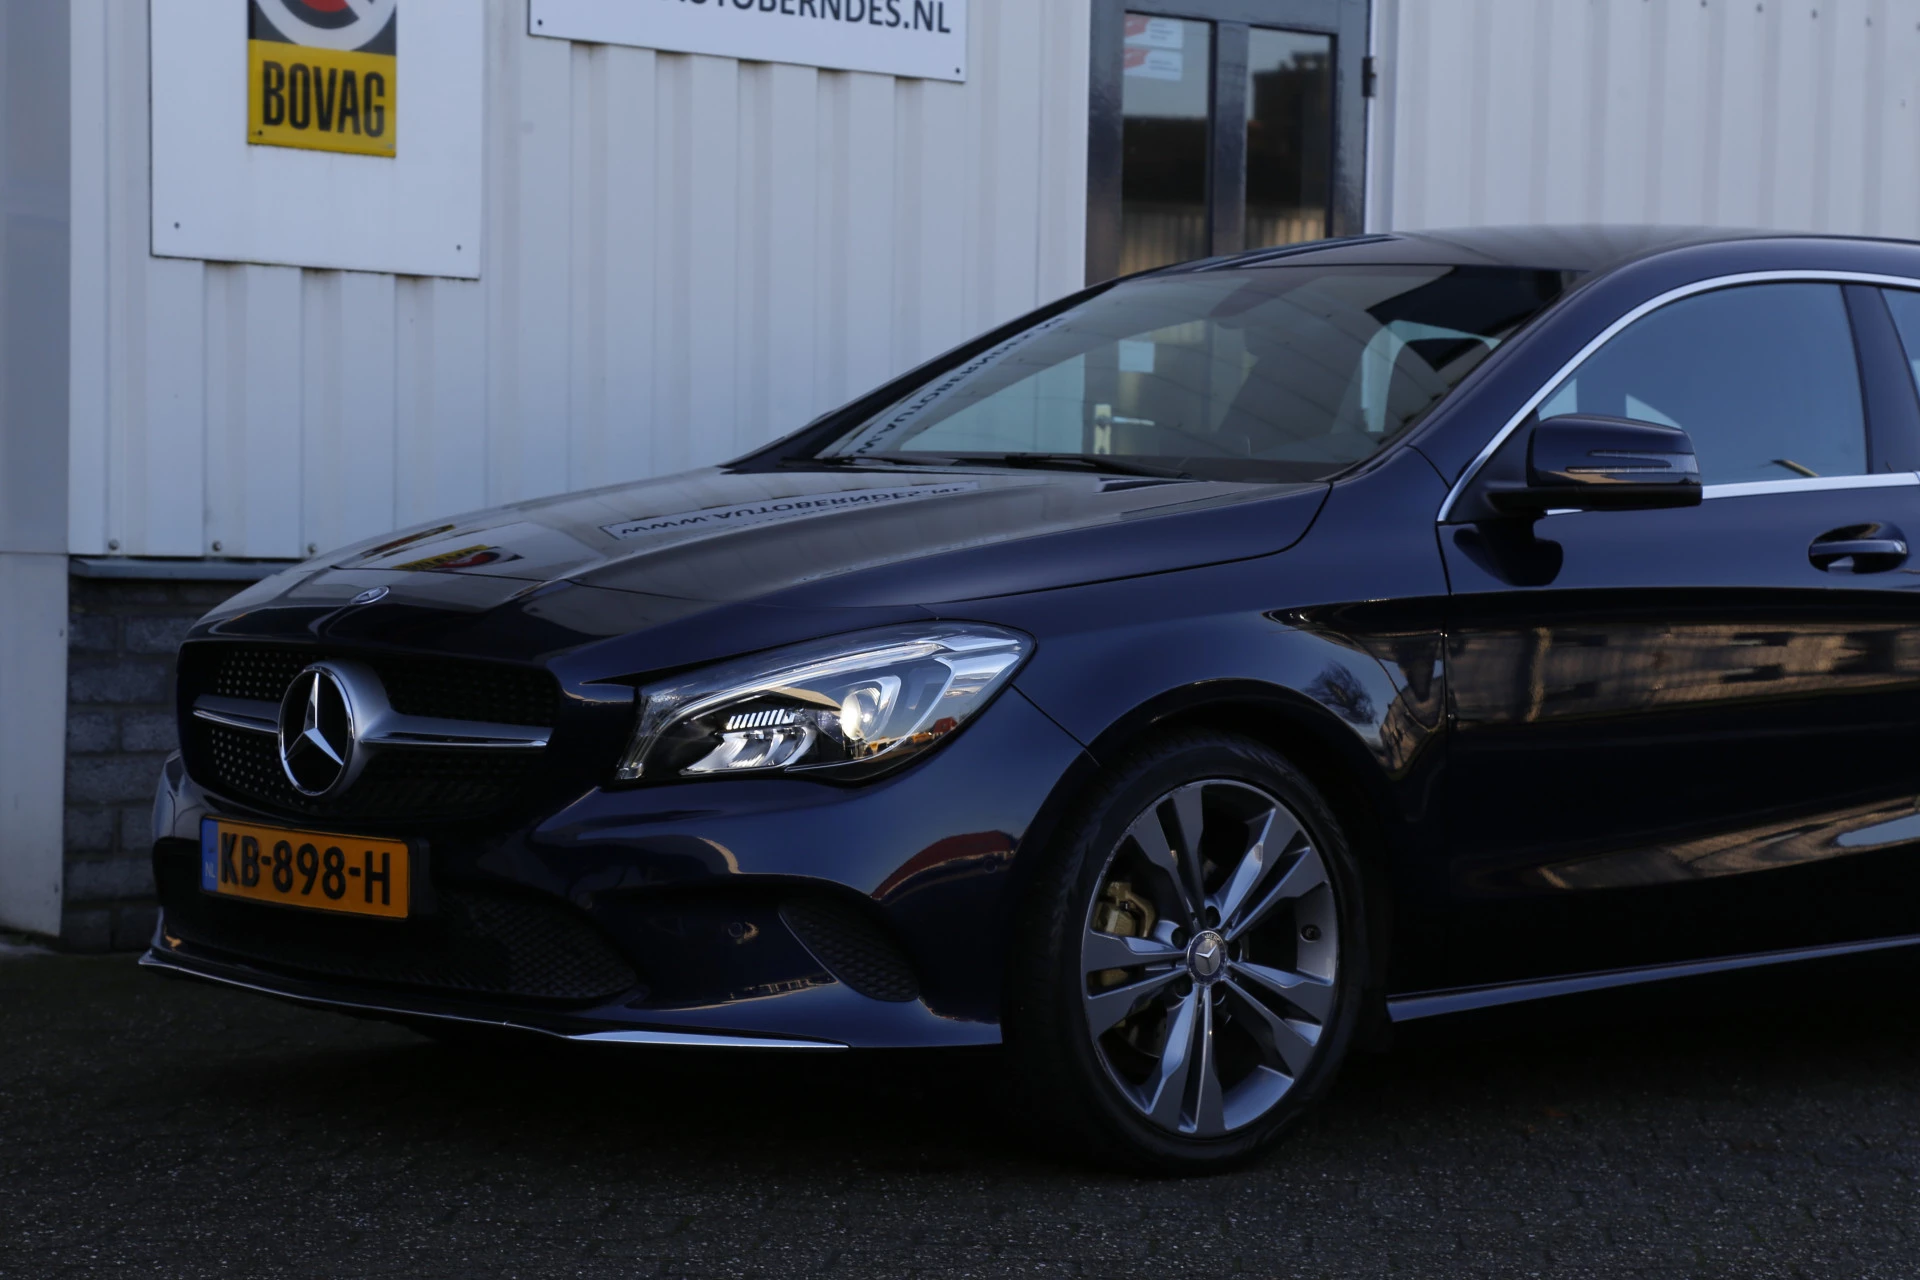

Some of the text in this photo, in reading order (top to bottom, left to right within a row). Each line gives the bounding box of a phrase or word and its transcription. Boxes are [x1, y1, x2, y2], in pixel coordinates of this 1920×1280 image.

[664, 0, 951, 33] RNDES.NL
[262, 60, 386, 138] BOVAG
[204, 860, 217, 879] NL
[220, 832, 391, 906] KB-898-H
